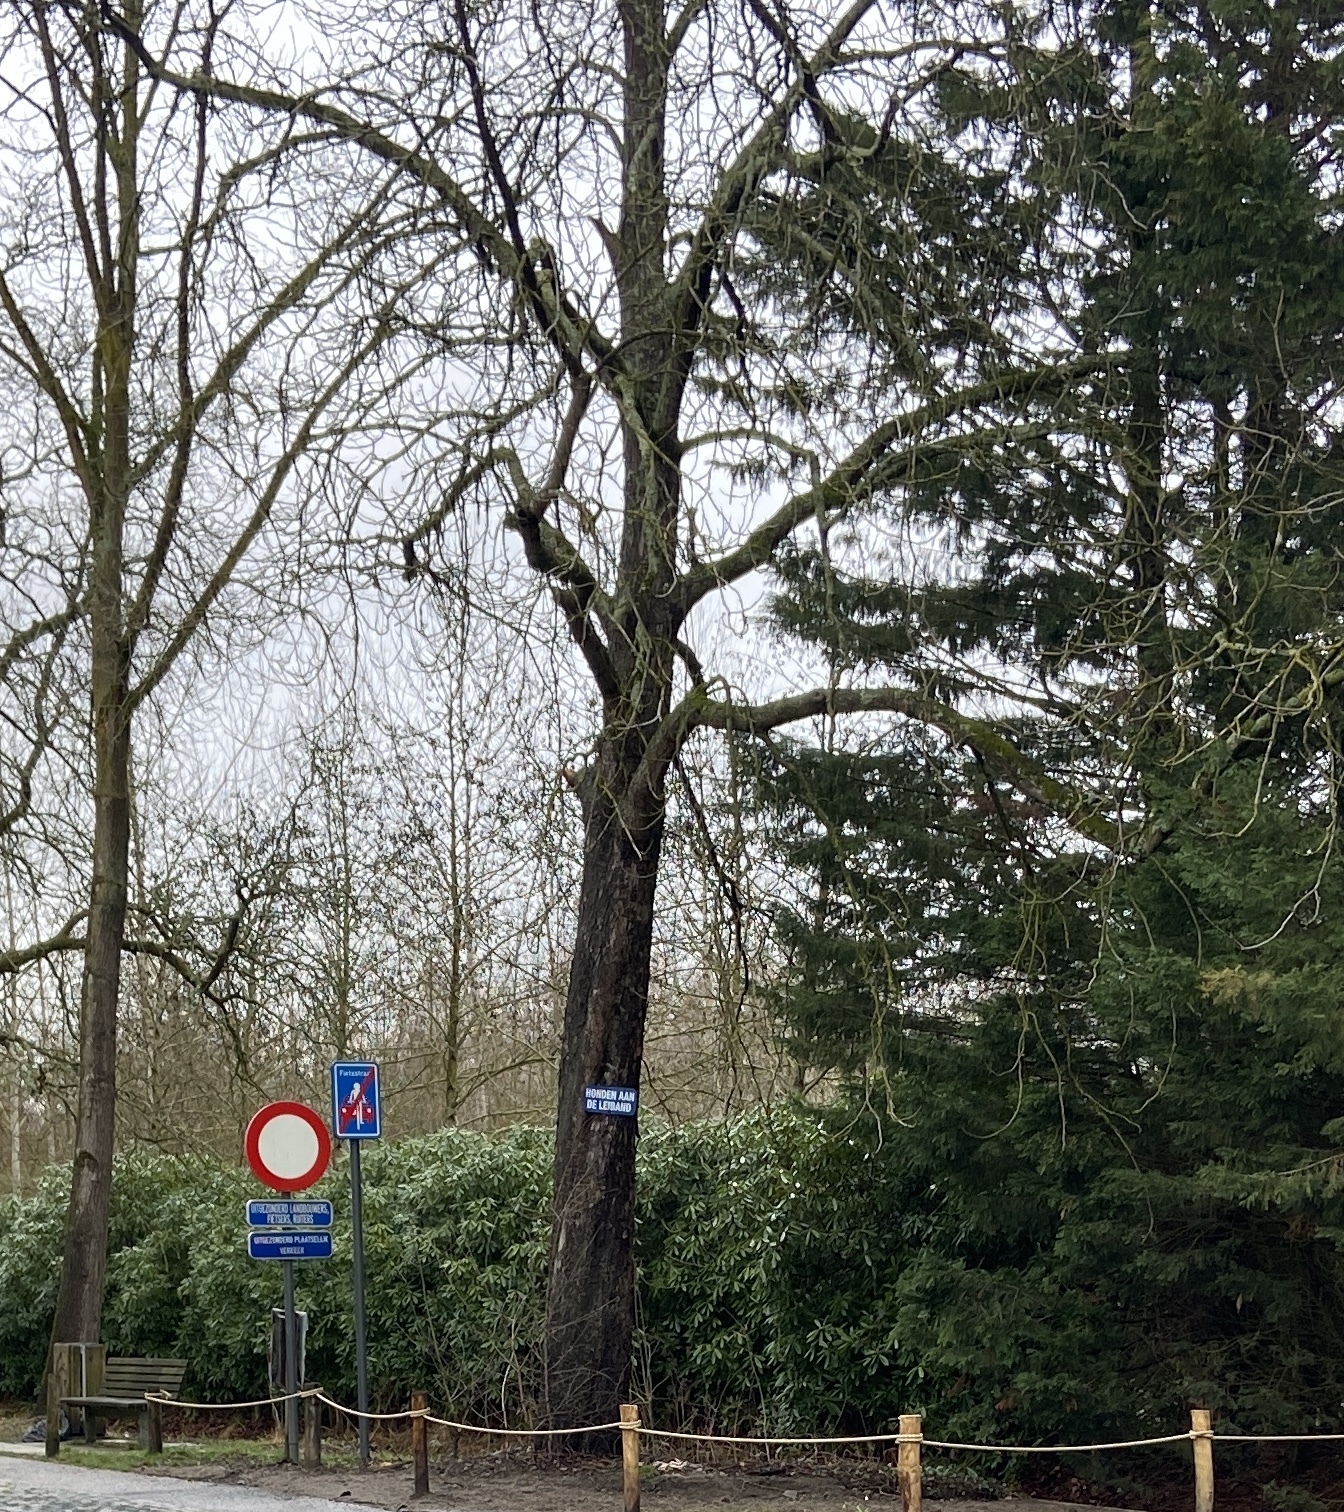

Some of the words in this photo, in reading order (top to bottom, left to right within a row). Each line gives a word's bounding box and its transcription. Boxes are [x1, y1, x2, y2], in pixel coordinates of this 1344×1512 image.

[585, 1087, 617, 1100] HONDEN
[618, 1091, 635, 1102] AAN
[586, 1099, 598, 1109] DE
[598, 1100, 632, 1112] LEIBAND
